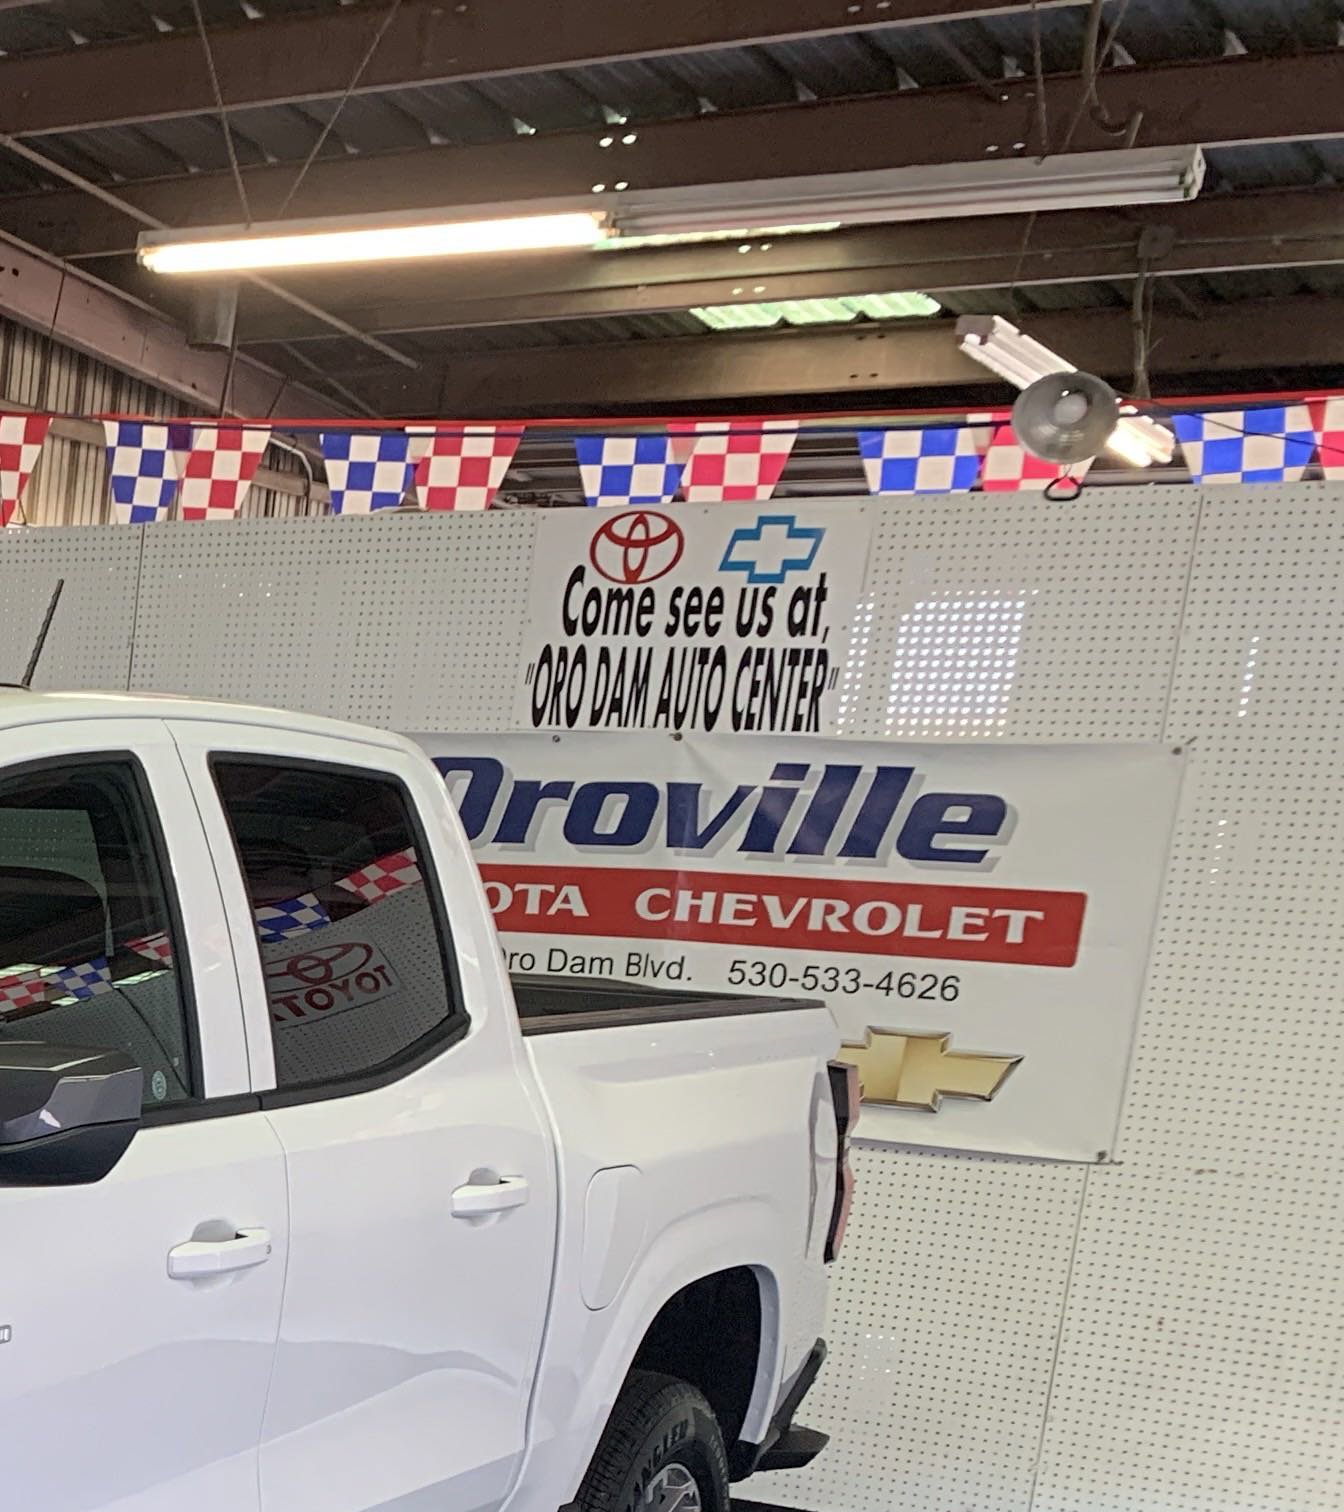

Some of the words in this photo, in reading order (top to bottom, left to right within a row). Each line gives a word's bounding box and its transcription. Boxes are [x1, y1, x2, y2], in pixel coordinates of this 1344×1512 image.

[562, 564, 655, 637] Come
[664, 586, 725, 637] see
[736, 585, 777, 637] us
[787, 571, 830, 644] at,
[589, 645, 654, 729] DAM
[653, 644, 727, 732] AUTO
[430, 756, 1009, 864] Oroville
[483, 881, 590, 918] OTA
[635, 887, 1045, 945] CHEVROLET
[546, 948, 614, 976] Dam
[624, 951, 693, 982] Blvd.
[727, 959, 961, 1001] 530-533-4626
